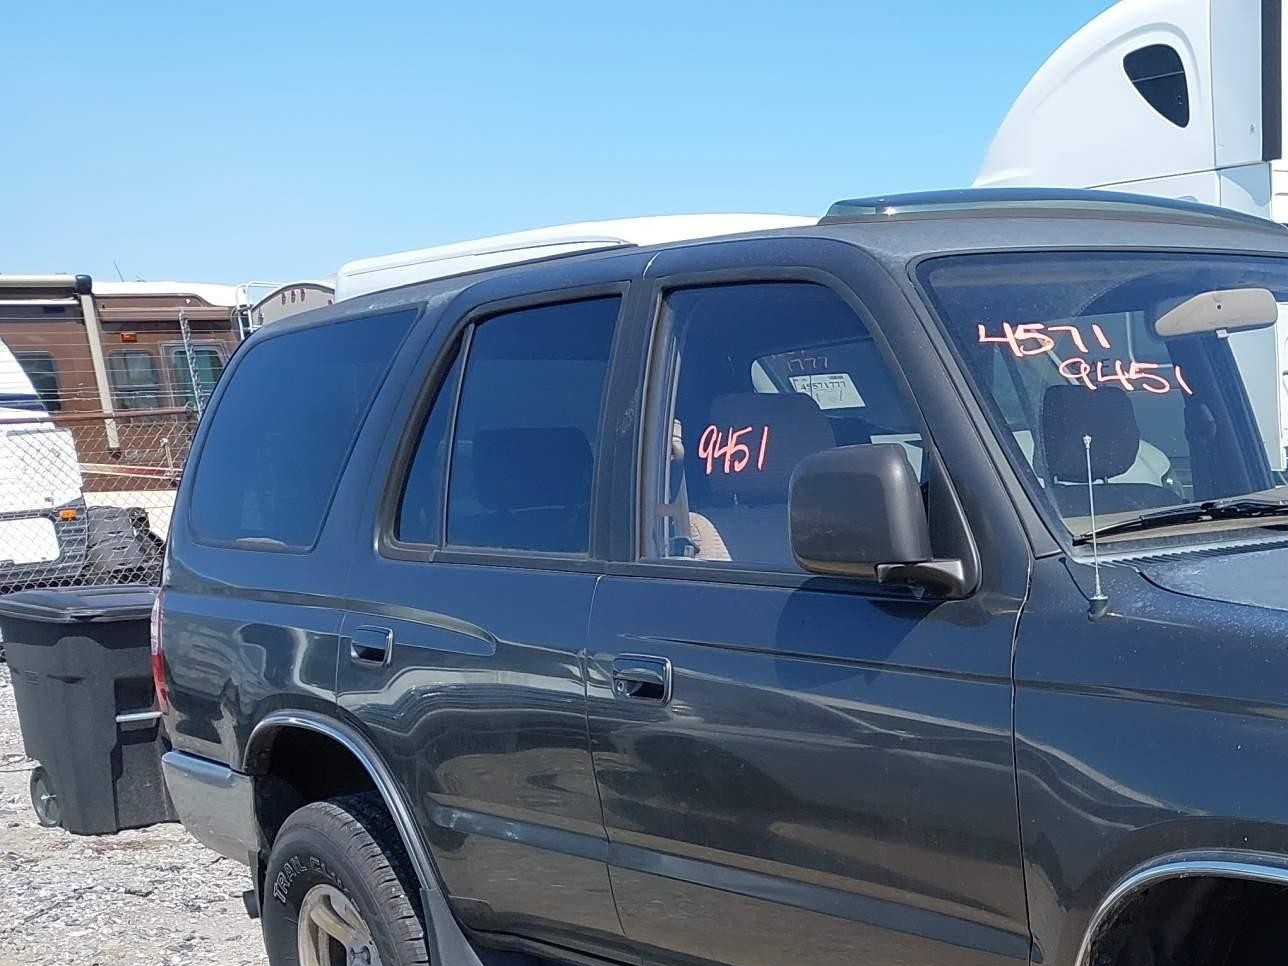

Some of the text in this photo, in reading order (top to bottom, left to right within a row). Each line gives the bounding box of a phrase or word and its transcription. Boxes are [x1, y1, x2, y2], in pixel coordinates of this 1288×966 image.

[978, 321, 1111, 357] 4571
[1059, 358, 1193, 395] 9451
[698, 424, 769, 475] 9451
[273, 855, 308, 904] TRAIL
